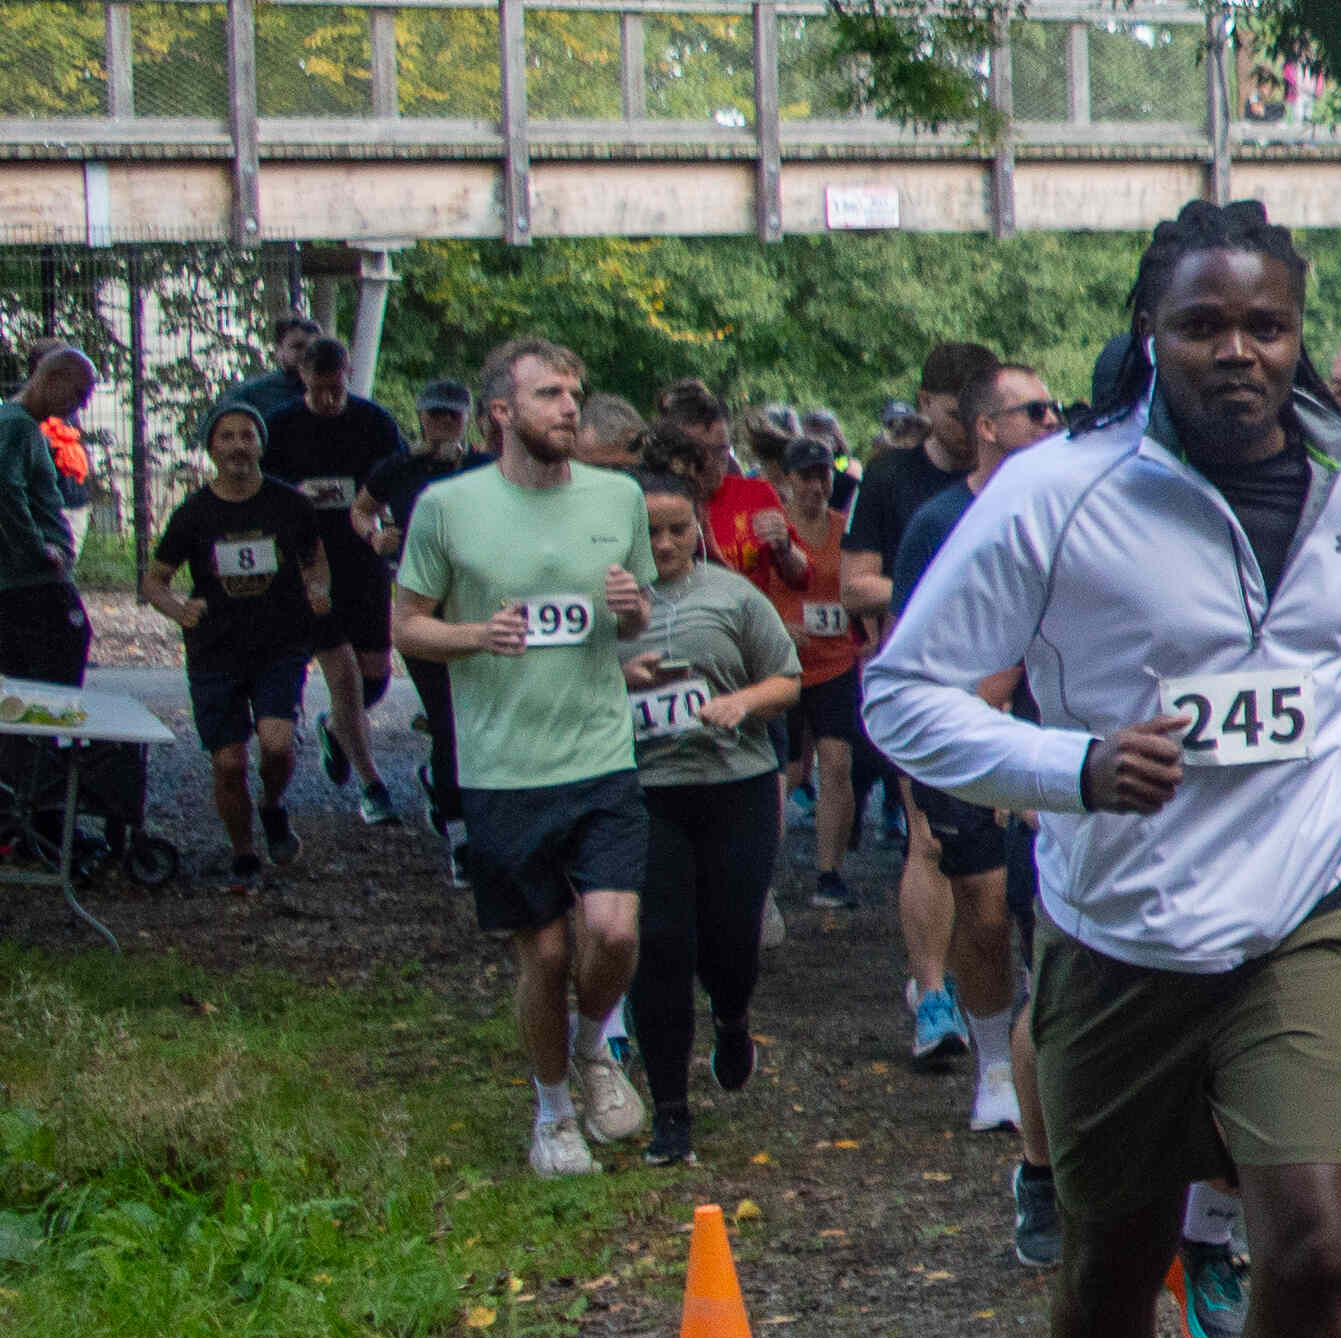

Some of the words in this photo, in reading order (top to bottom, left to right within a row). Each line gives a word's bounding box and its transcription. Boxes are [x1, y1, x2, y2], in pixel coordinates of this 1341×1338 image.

[239, 547, 256, 570] 8
[816, 607, 840, 630] 31
[636, 689, 706, 730] 170
[1173, 686, 1305, 750] 245
